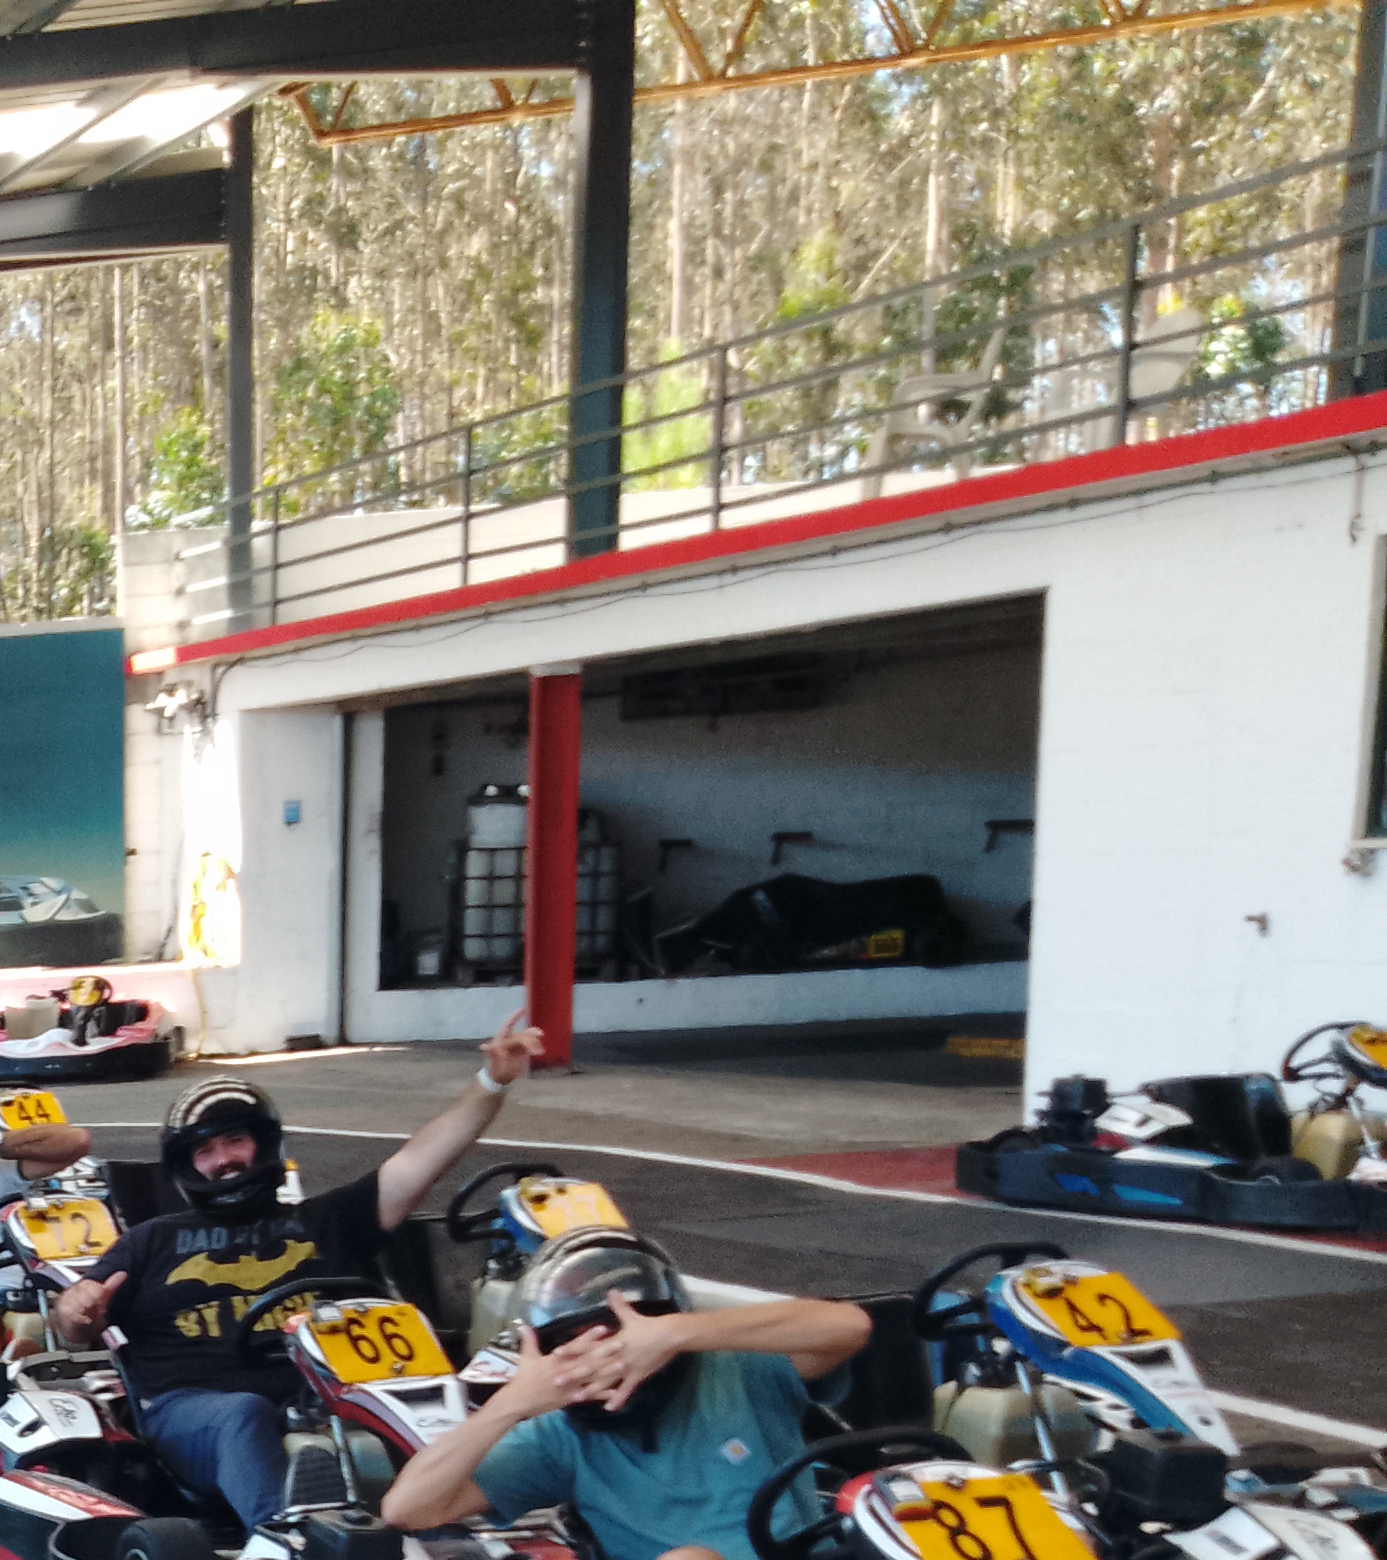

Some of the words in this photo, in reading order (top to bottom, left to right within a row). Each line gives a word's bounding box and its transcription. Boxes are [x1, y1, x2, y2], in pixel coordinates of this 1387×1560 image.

[17, 1103, 53, 1123] 44
[345, 1314, 415, 1365] 66
[1063, 1292, 1154, 1341] 42
